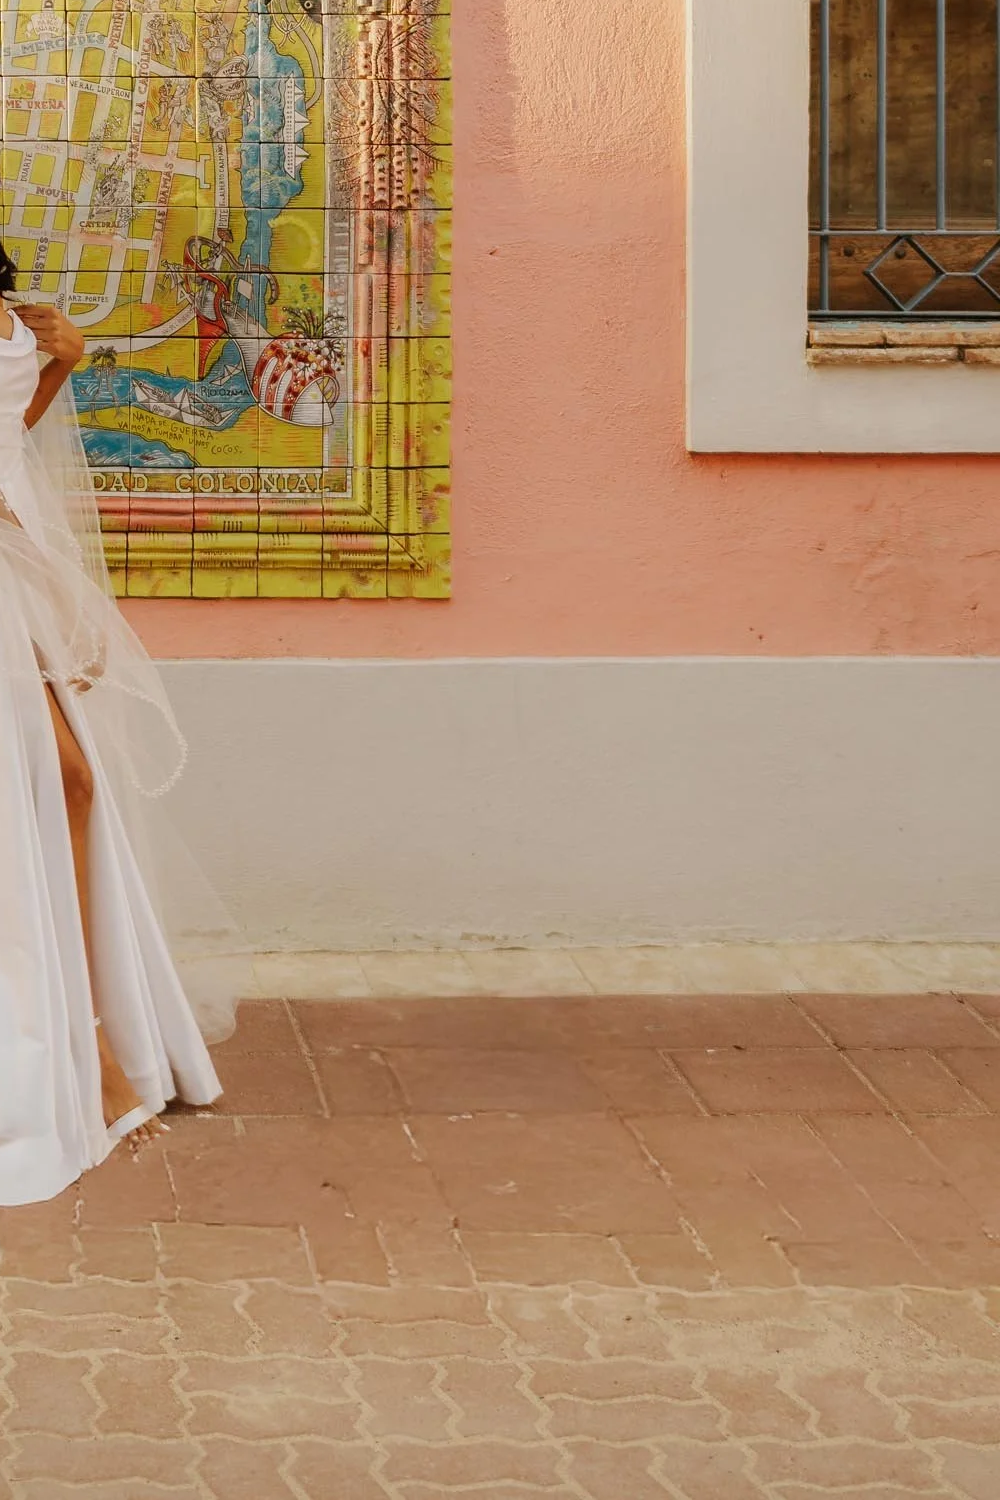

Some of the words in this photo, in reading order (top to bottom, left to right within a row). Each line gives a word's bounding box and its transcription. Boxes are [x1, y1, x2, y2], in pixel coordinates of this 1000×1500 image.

[21, 34, 106, 54] MERCEDES
[21, 151, 33, 182] DUARTE
[158, 161, 174, 205] DAMAS
[36, 187, 76, 203] NOUEL
[154, 210, 166, 232] LAS
[30, 236, 49, 291] HOSTOS
[57, 293, 65, 310] RIÑO
[132, 411, 156, 426] NADA
[170, 423, 214, 440] GUERRA
[155, 429, 184, 441] TUMBAR
[188, 438, 210, 449] UNOS
[174, 472, 330, 493] COLONIAL
